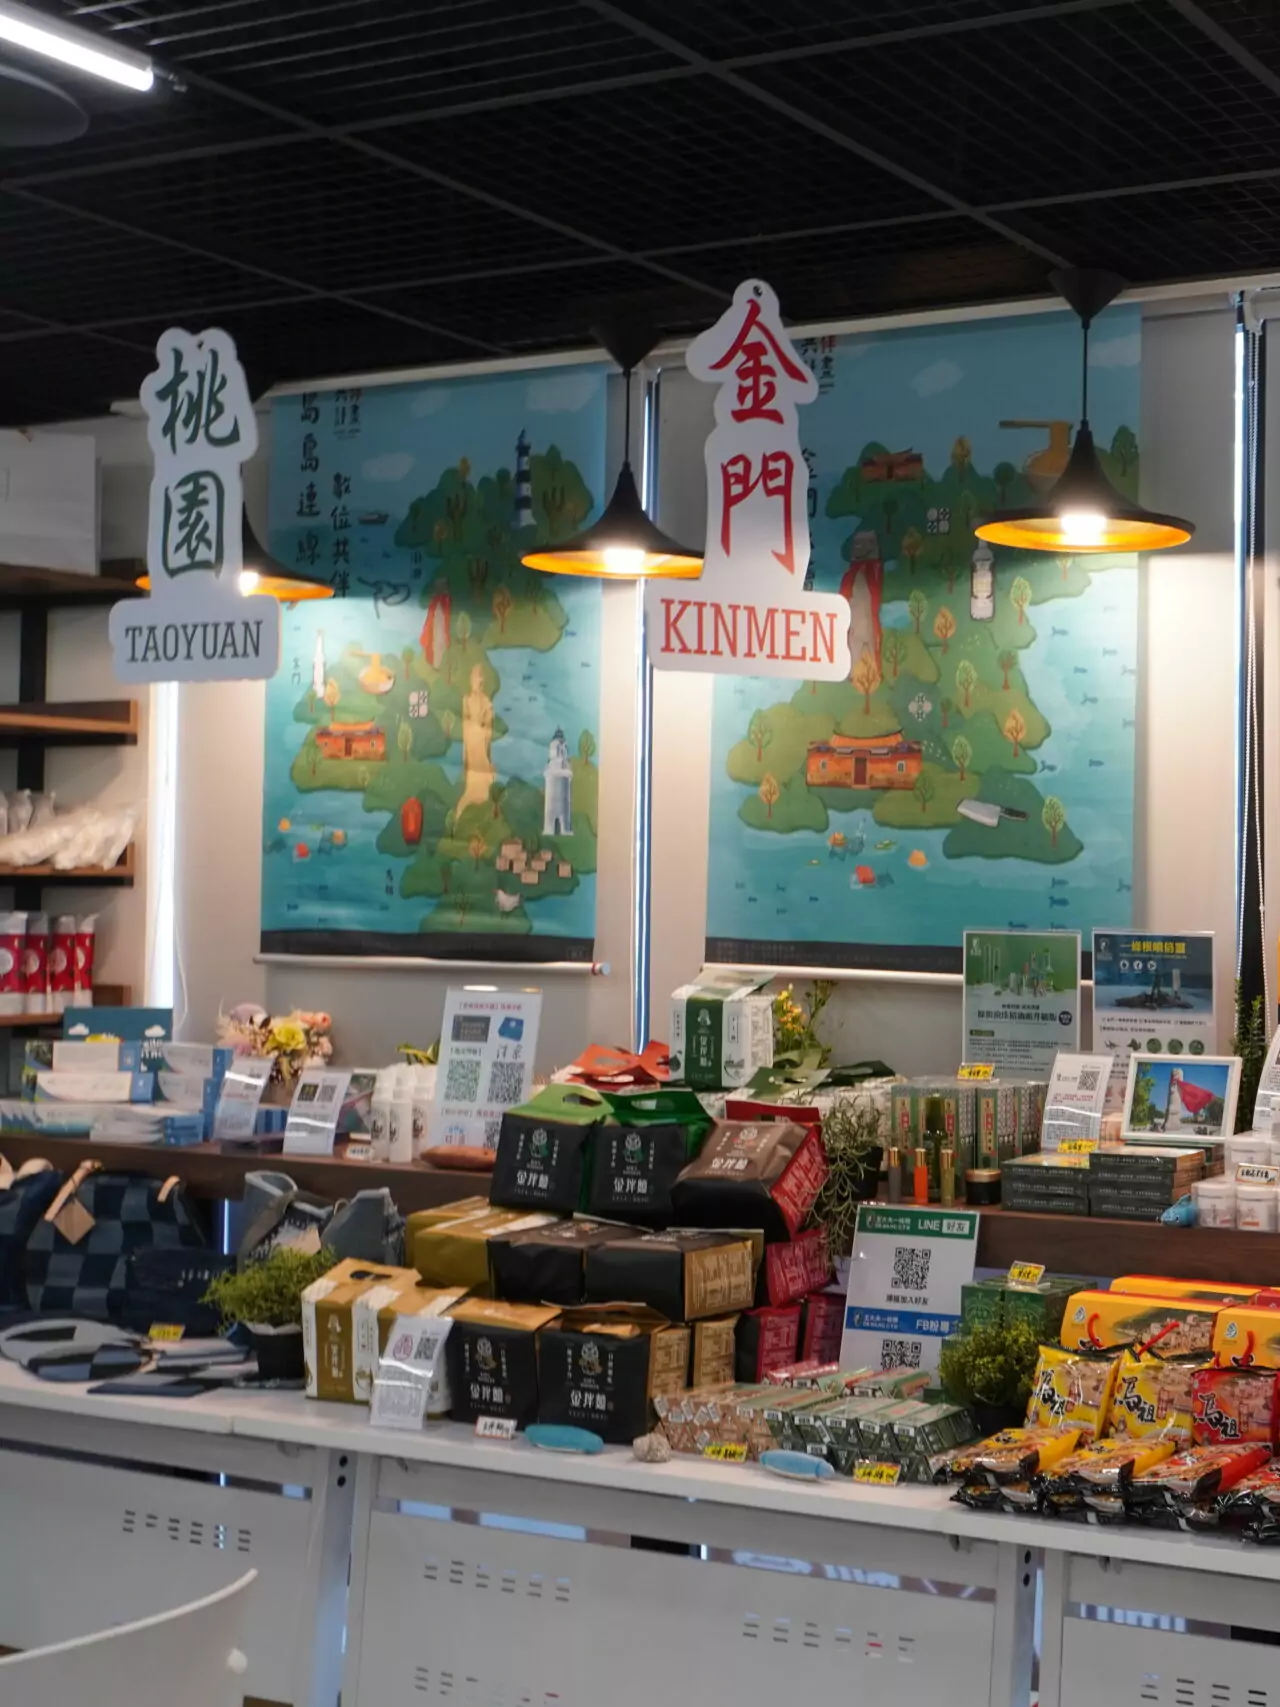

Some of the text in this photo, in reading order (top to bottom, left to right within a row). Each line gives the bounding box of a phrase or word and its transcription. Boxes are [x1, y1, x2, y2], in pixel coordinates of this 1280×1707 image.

[154, 346, 240, 580] 桃園
[708, 298, 808, 575] 金門
[125, 619, 264, 664] TAOYUAN
[660, 597, 838, 664] KINMEN
[917, 1218, 941, 1231] LINE
